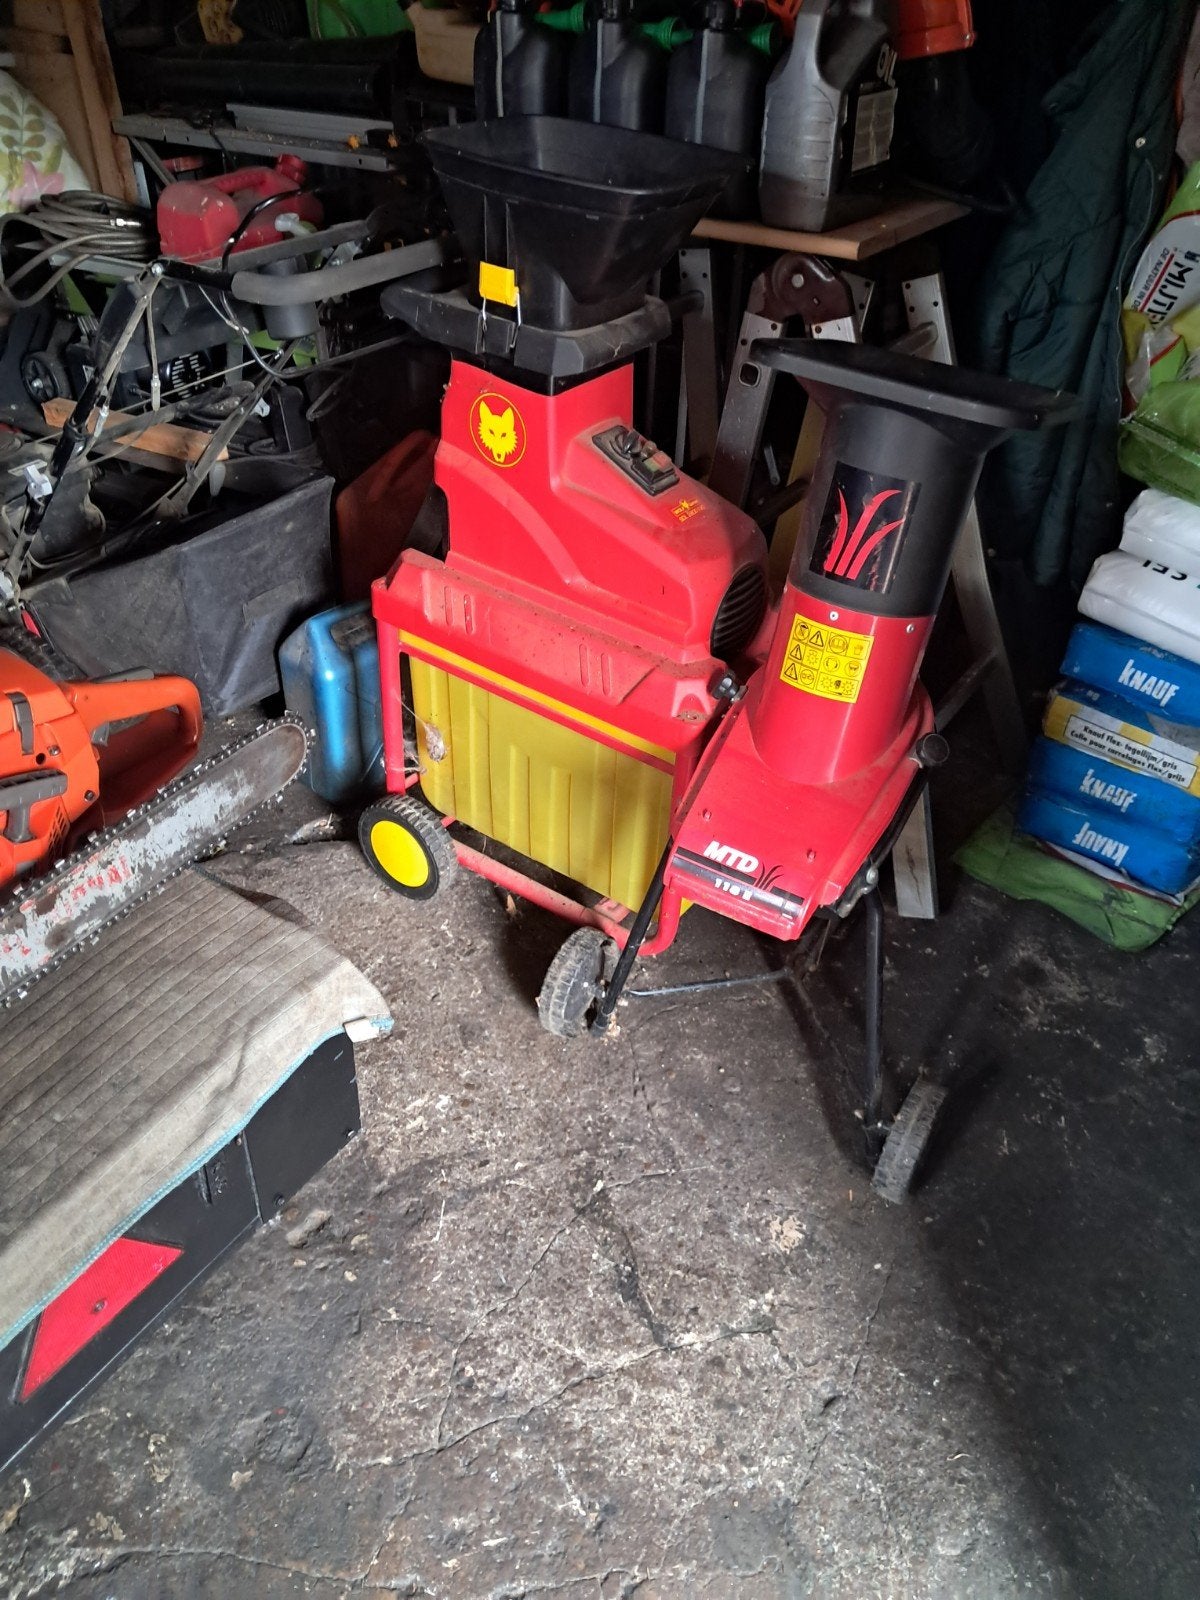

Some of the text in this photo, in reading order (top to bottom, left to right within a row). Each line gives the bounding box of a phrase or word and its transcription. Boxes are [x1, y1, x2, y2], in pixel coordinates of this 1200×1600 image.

[1117, 658, 1180, 707] KNAUF
[1070, 730, 1088, 742] Colle
[1089, 739, 1106, 750] pour
[1107, 747, 1146, 766] carrelages
[1083, 725, 1106, 740] Knauf
[1079, 768, 1138, 813] KNAUF
[703, 840, 759, 873] MTD
[1072, 821, 1130, 867] KNAUF
